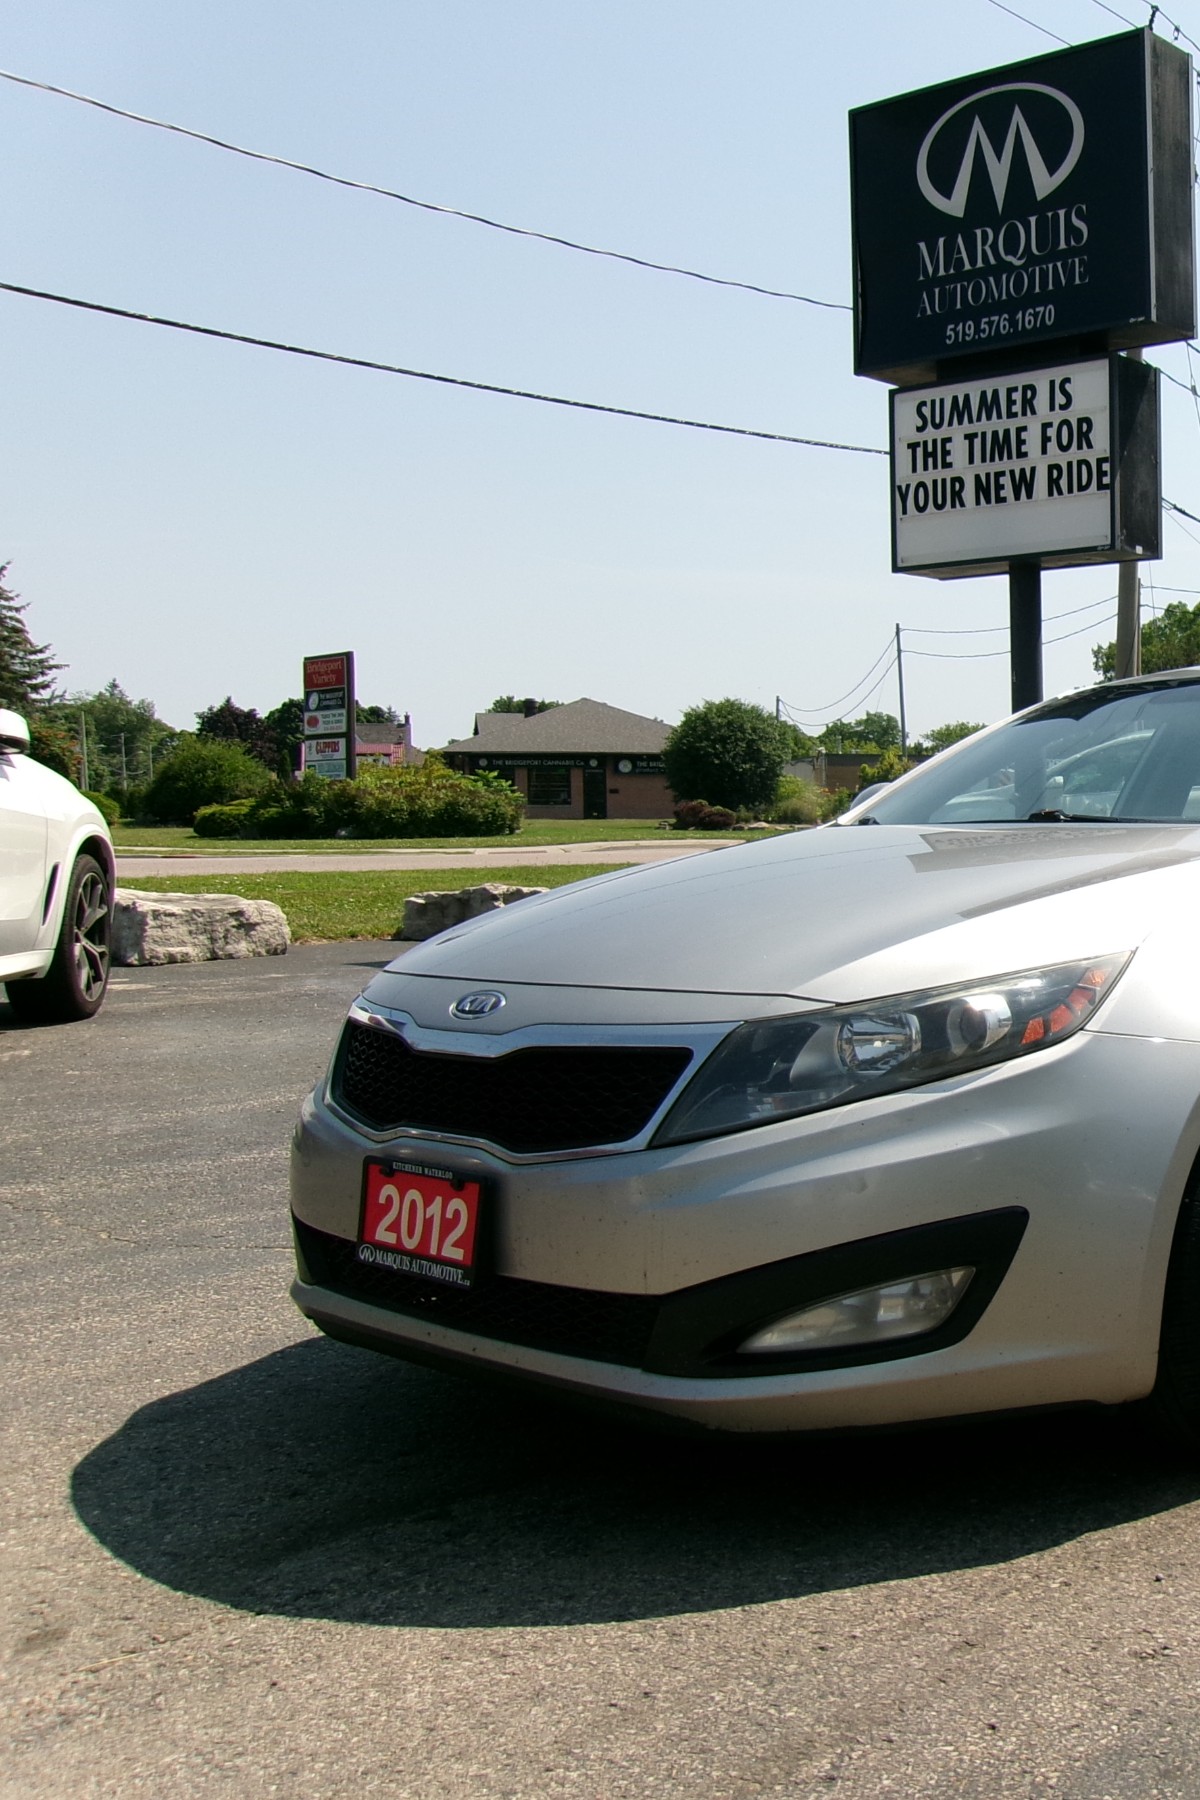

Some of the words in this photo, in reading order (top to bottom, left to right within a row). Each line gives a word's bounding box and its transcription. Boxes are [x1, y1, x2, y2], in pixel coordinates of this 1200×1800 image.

[917, 203, 1090, 281] MARQUIS
[916, 255, 1090, 318] AUTOMOTIVE
[945, 304, 1056, 345] 519.576.1670
[915, 383, 1038, 433] SUMMER
[1049, 377, 1073, 413] IS
[907, 436, 953, 474] THE
[963, 425, 1029, 465] TIME
[1041, 416, 1094, 455] FOR
[897, 475, 966, 516] YOUR
[974, 465, 1037, 506] NEW
[1047, 456, 1111, 498] RIDE
[306, 660, 342, 674] Bridgeport
[312, 673, 337, 685] Variety
[392, 1161, 423, 1174] KITCHENER
[424, 1167, 453, 1180] WATERLOO
[375, 1184, 468, 1261] 2012
[374, 1249, 411, 1271] MARQUIS
